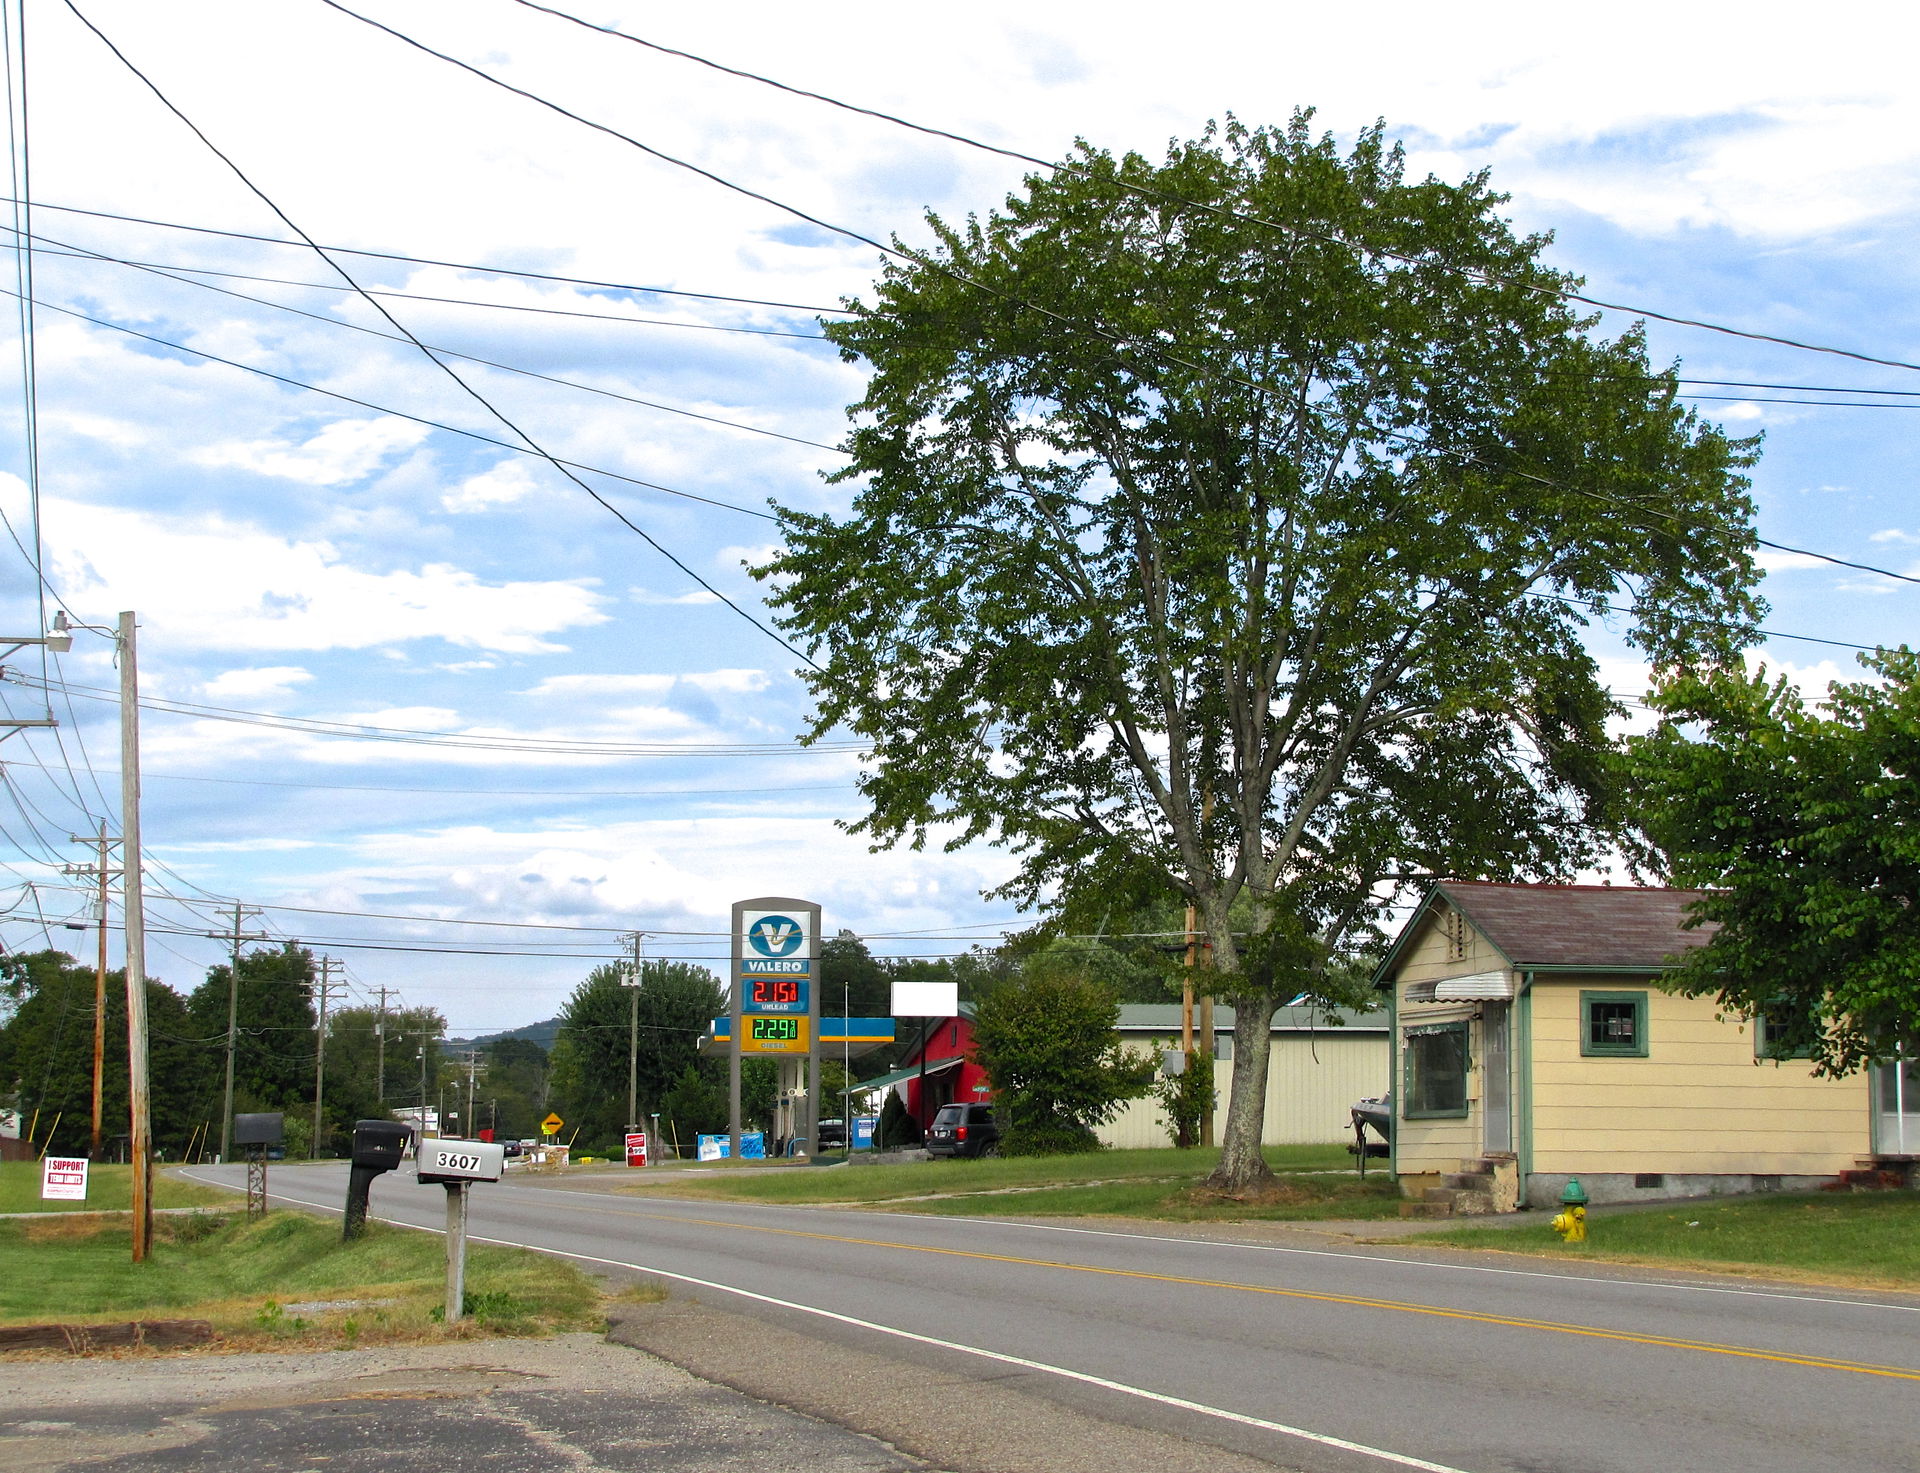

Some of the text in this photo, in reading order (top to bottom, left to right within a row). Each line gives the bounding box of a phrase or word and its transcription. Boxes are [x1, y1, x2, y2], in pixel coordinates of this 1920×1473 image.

[748, 961, 803, 972] VALERO
[52, 1160, 84, 1171] SUPPORT
[438, 1153, 479, 1170] 3607
